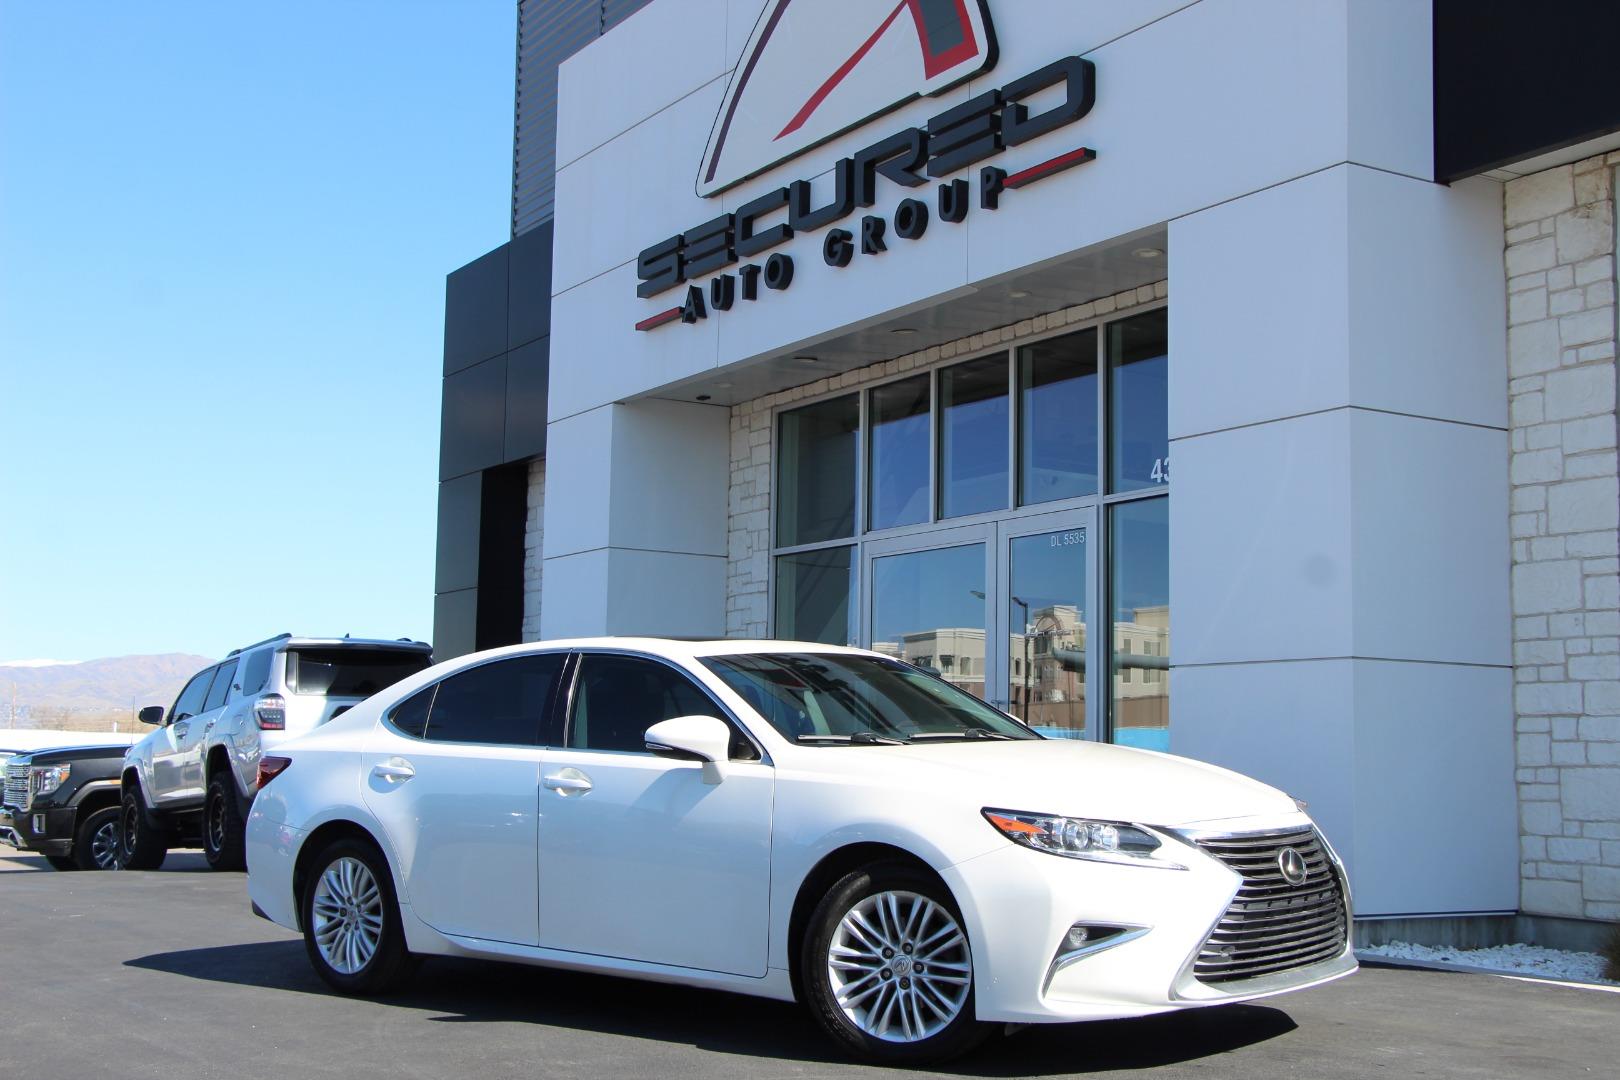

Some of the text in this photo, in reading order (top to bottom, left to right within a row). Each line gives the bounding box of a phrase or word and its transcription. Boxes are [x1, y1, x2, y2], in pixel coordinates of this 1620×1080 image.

[636, 55, 1096, 299] SECURED
[681, 165, 1008, 324] AUTO GROUP
[1050, 535, 1062, 547] DL
